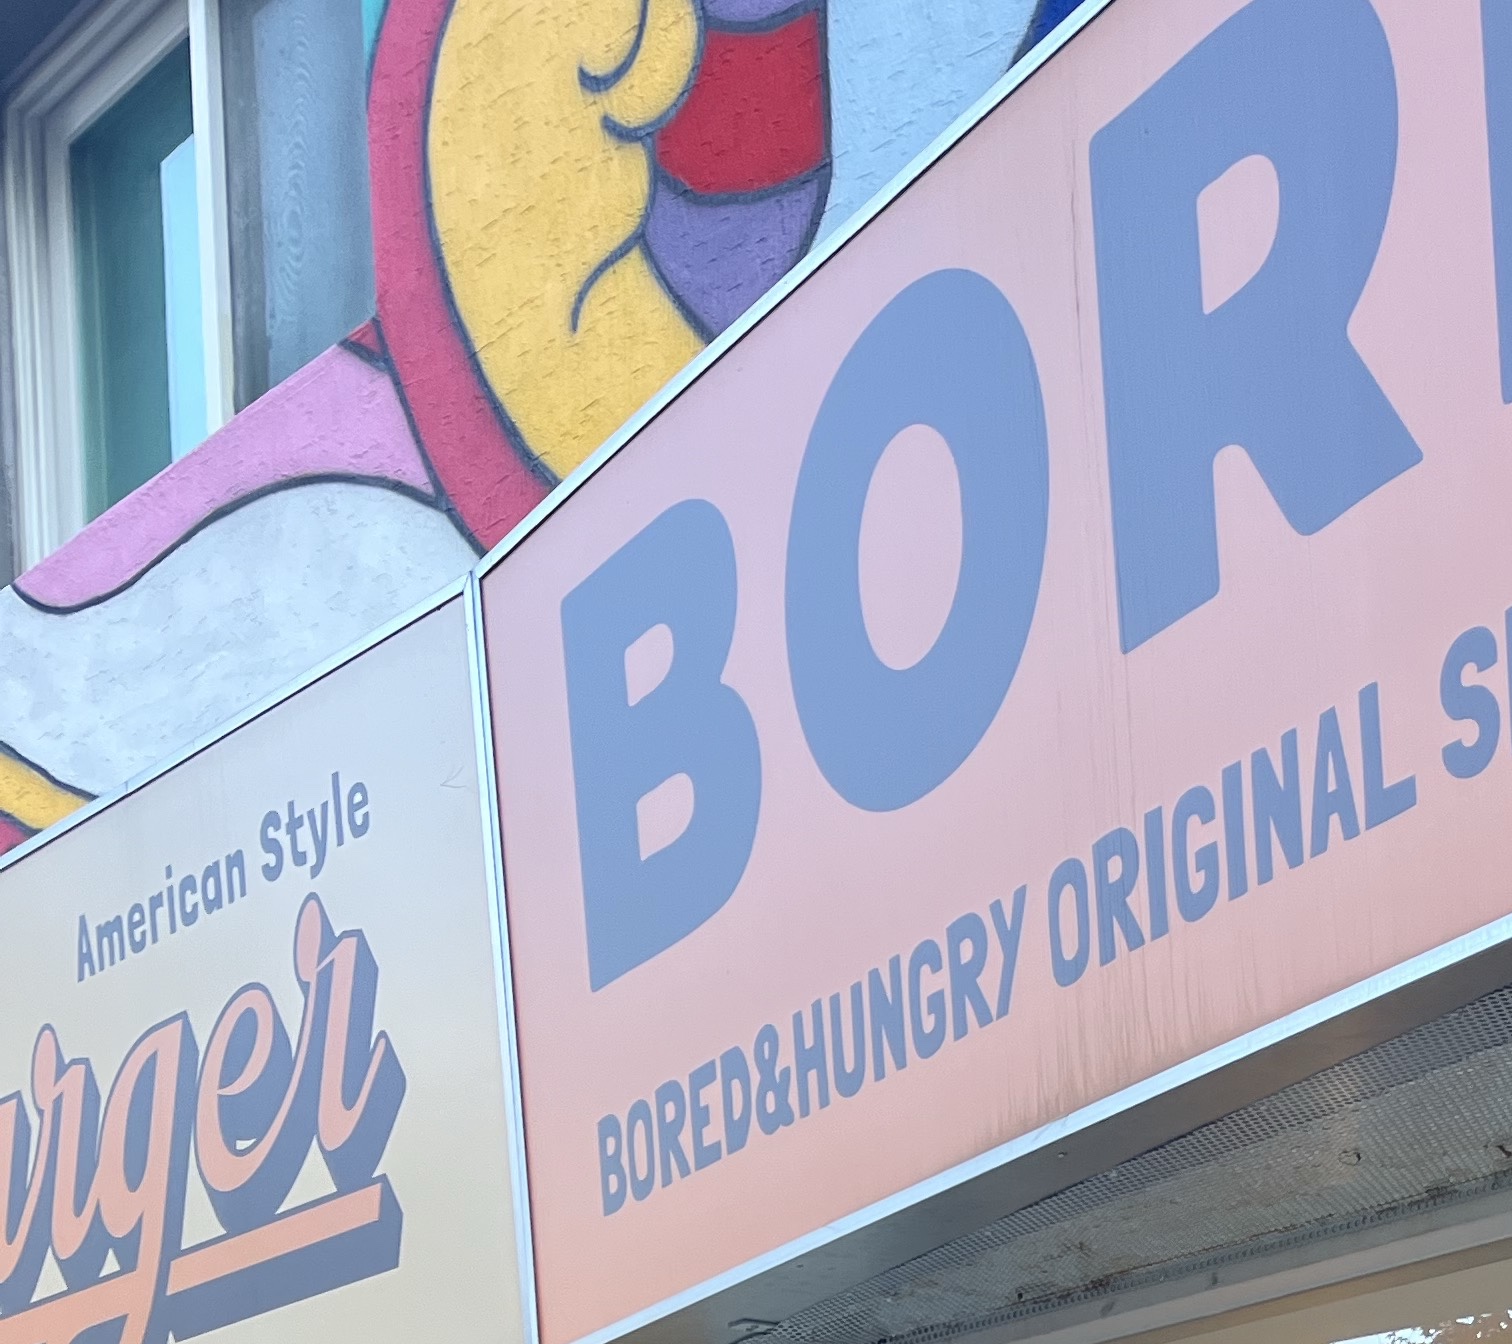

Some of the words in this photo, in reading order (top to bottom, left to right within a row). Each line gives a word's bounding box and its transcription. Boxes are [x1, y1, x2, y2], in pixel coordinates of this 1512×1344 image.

[77, 847, 248, 982] American
[260, 770, 371, 885] Style
[600, 883, 1029, 1215] BORED&HUNGRY
[1047, 684, 1416, 986] ORIGINAL
